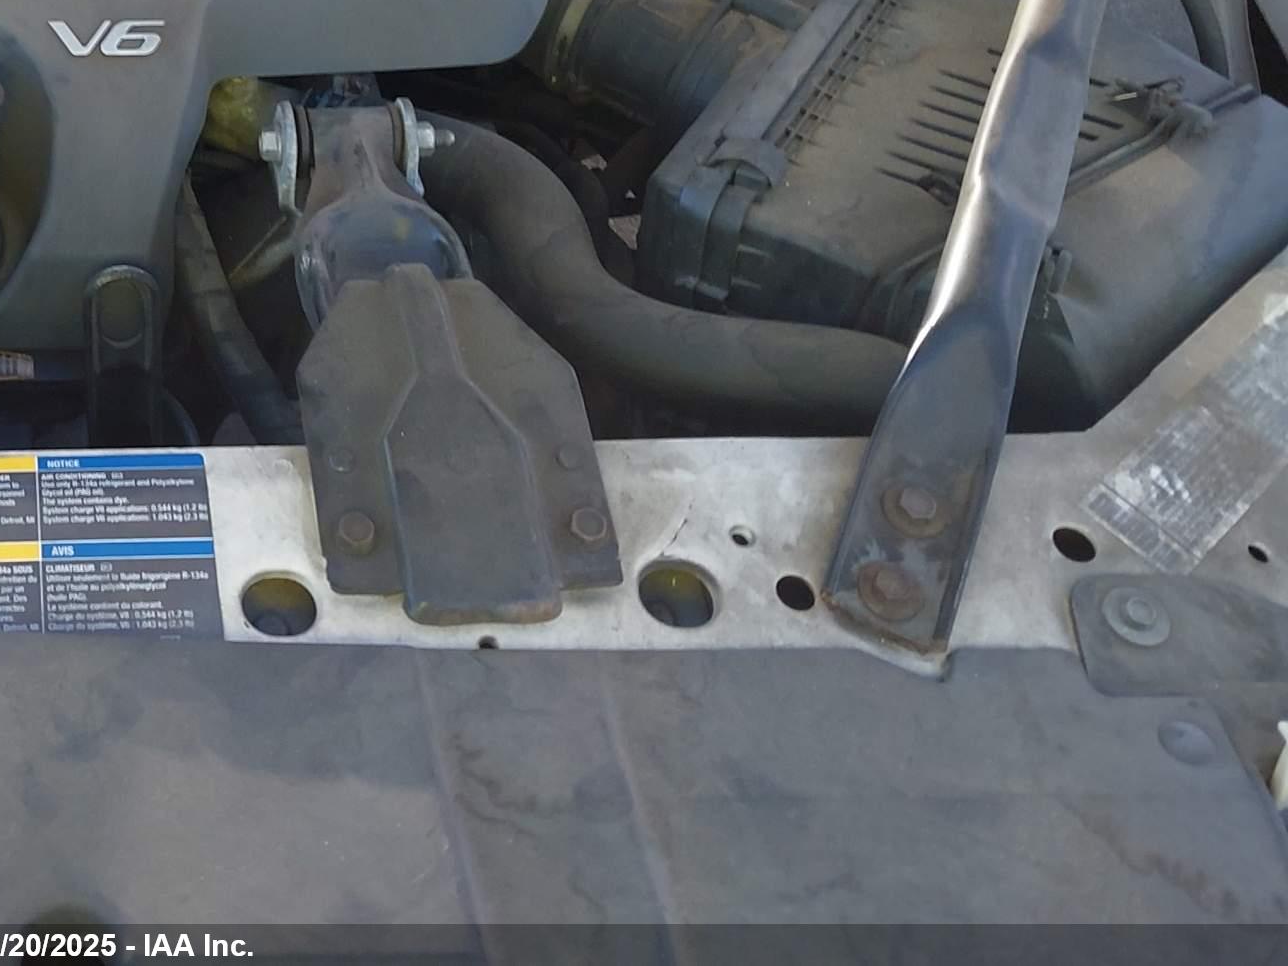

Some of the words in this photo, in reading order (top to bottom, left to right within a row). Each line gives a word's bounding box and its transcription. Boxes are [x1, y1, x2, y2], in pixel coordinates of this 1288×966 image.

[47, 20, 165, 57] V6
[47, 459, 80, 468] NOTICE
[51, 545, 74, 556] AVIS
[12, 565, 33, 574] SOUS
[45, 564, 96, 573] CLIMATISEUR
[58, 602, 88, 612] système
